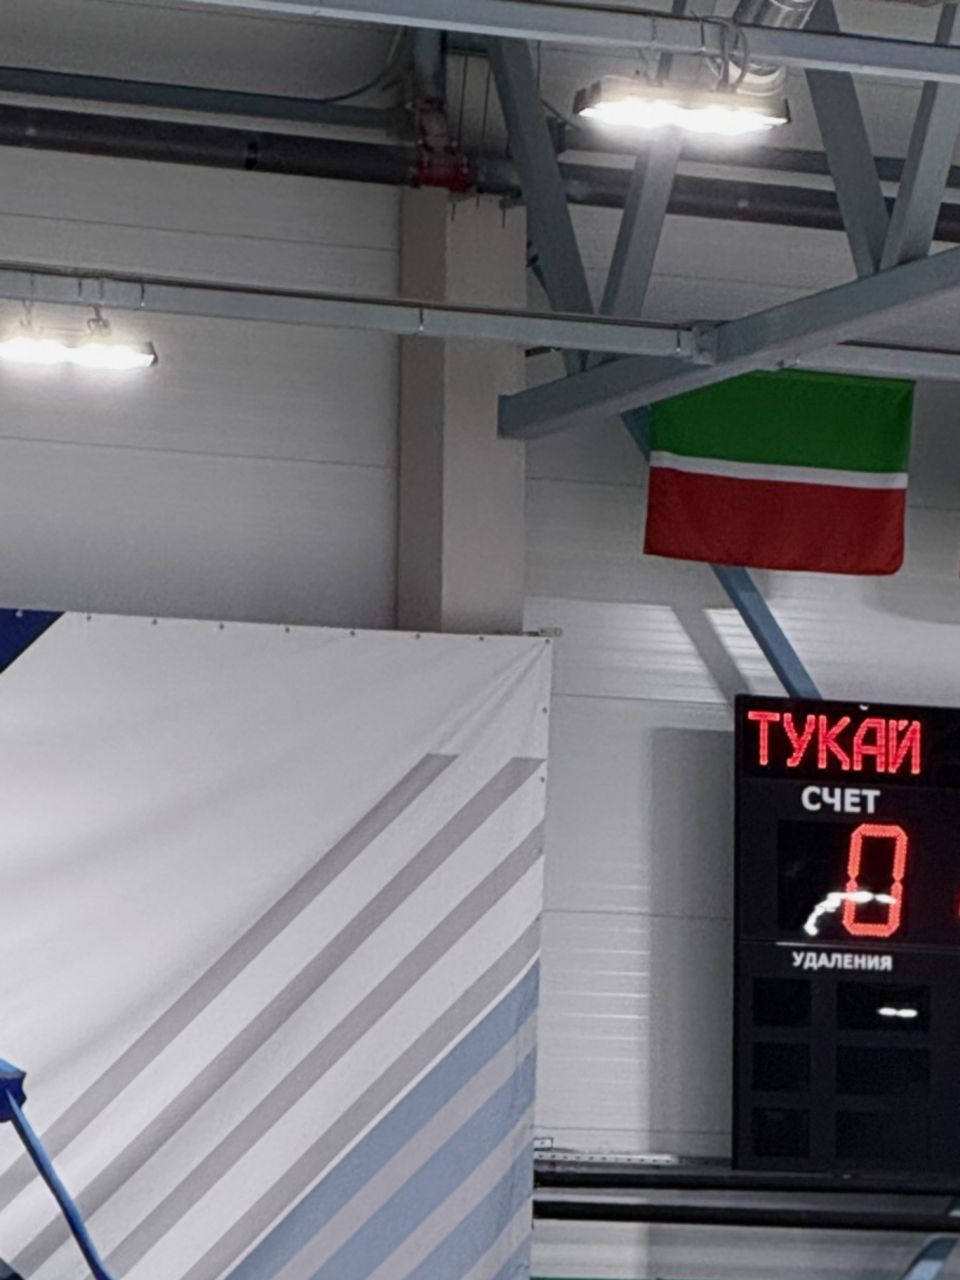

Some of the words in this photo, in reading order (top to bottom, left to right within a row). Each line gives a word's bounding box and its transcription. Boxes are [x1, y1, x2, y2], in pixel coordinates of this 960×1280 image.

[748, 711, 921, 774] ТУКАЙ
[801, 786, 880, 814] СЧЕТ
[842, 823, 908, 938] 0
[792, 952, 893, 972] УДАЛЕНИЯ
